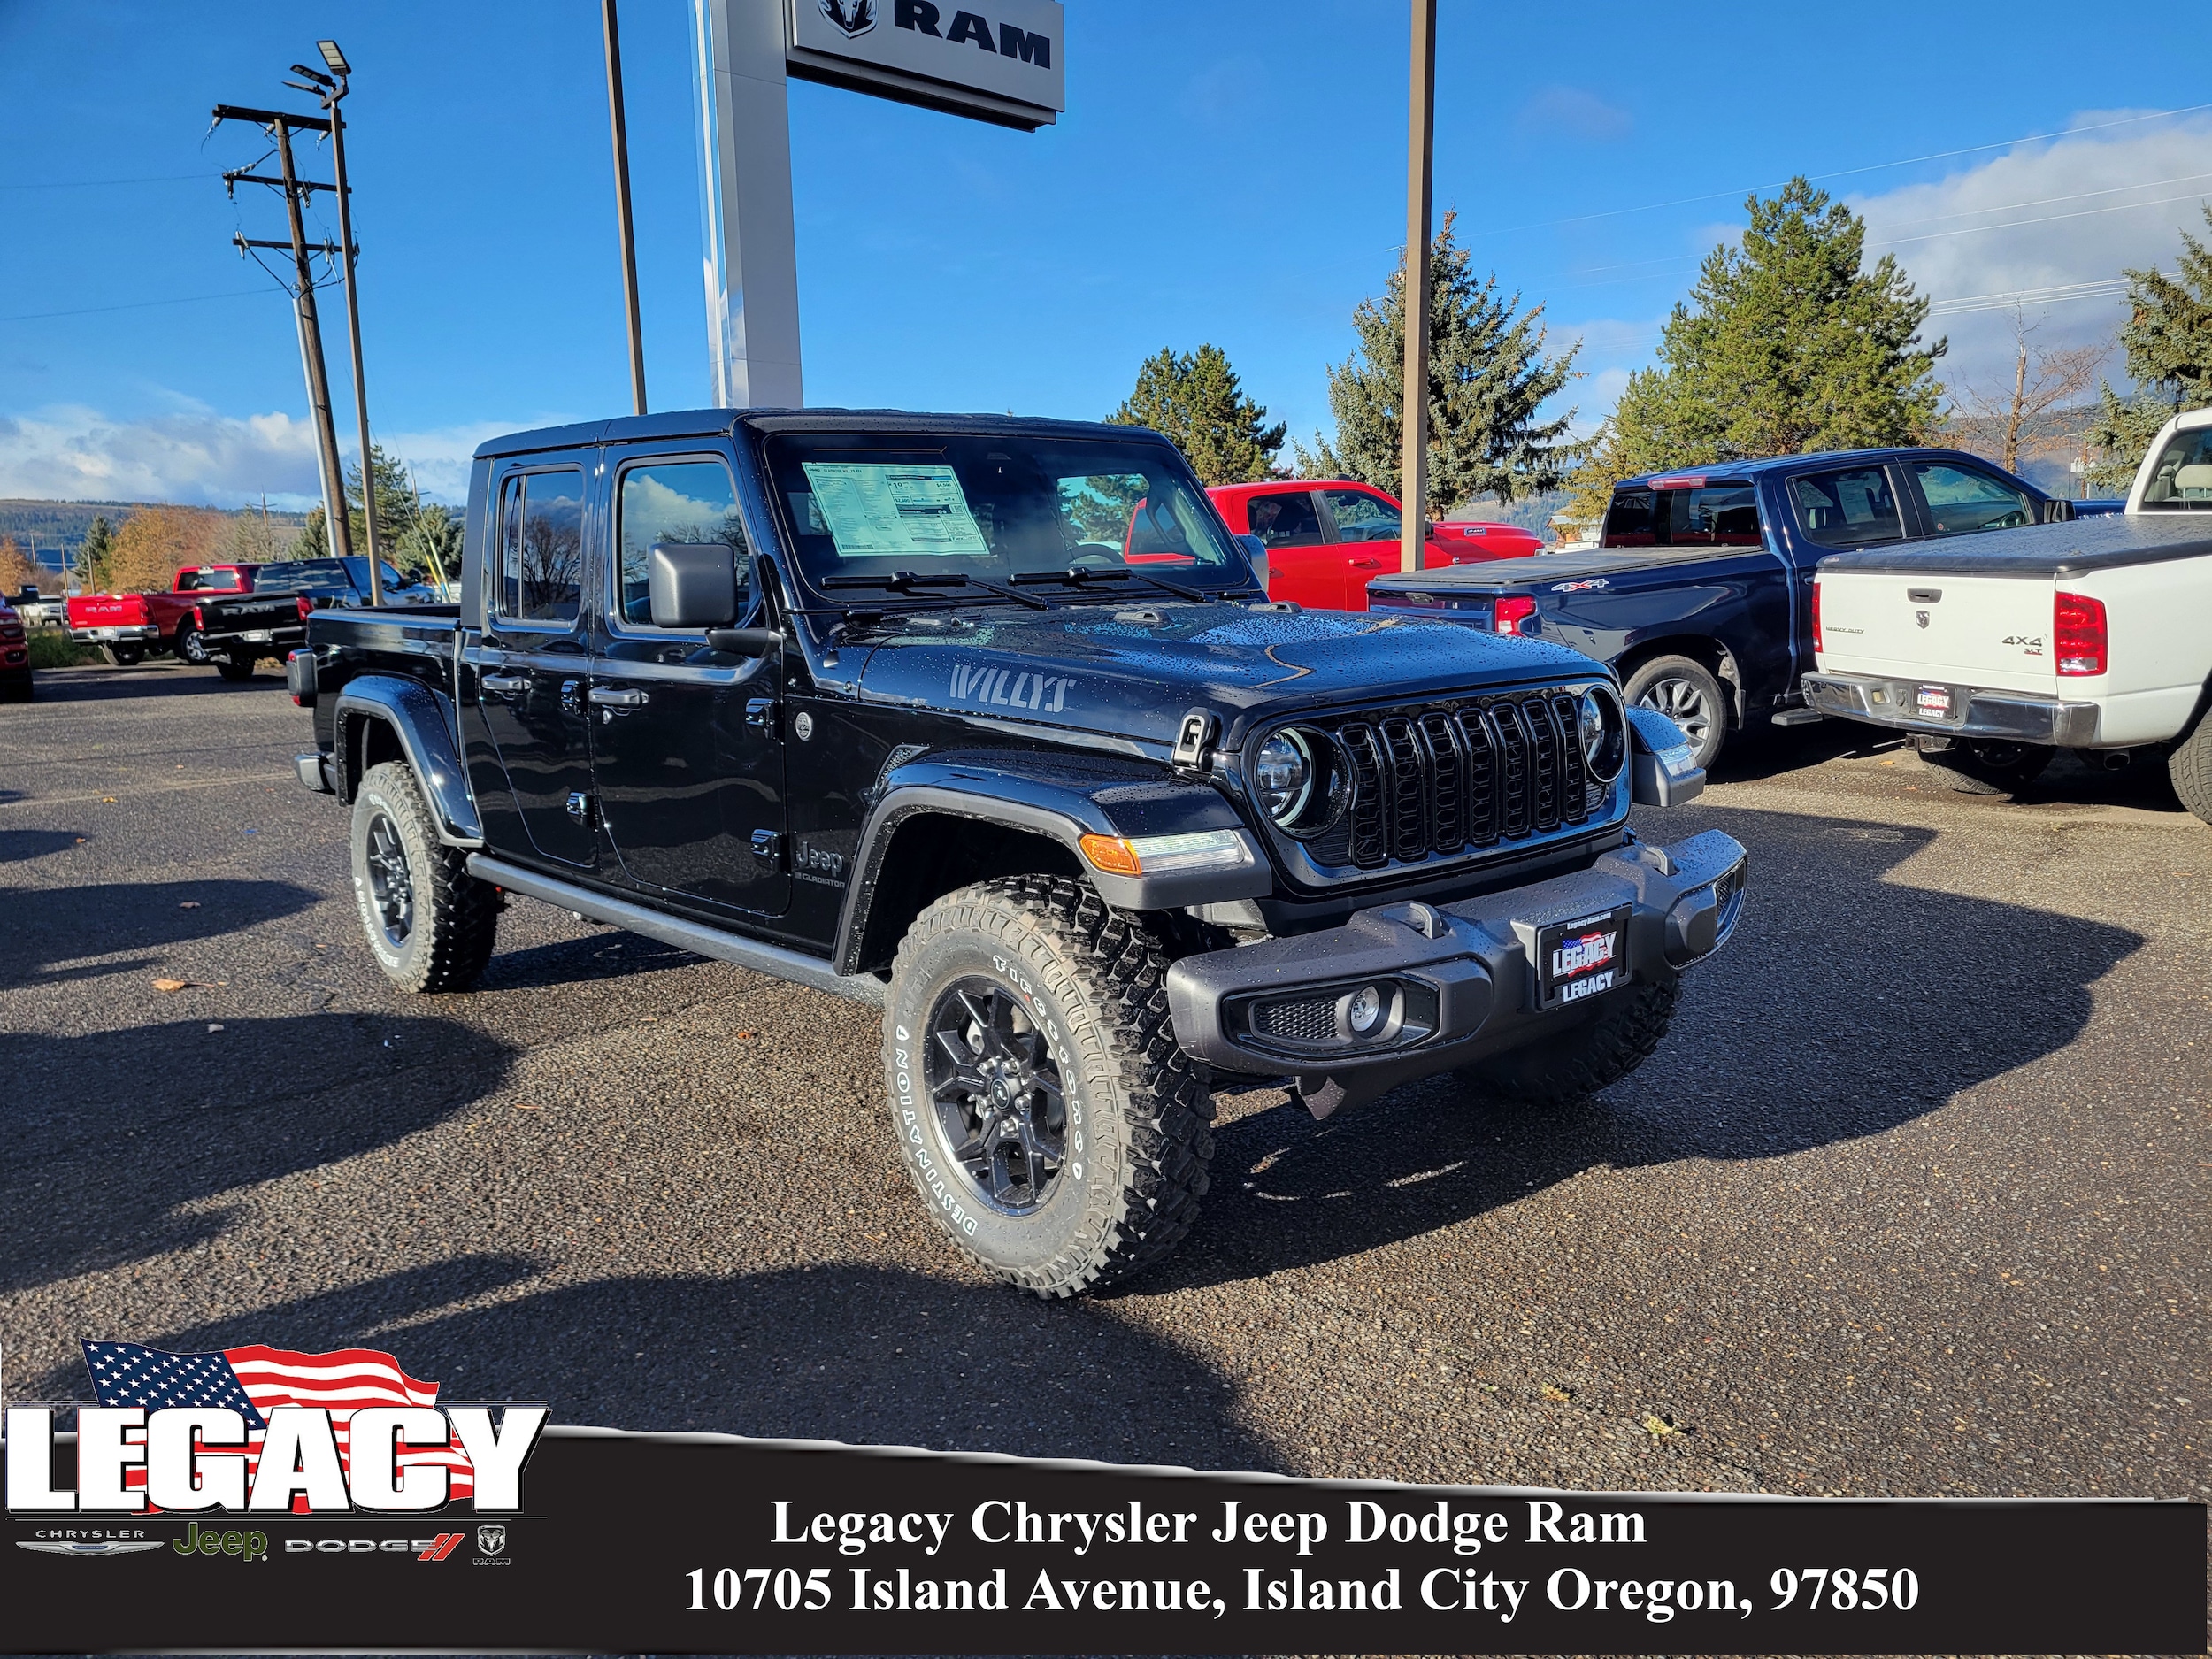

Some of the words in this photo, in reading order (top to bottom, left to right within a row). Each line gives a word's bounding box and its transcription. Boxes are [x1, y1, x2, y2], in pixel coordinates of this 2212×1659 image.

[895, 0, 1050, 69] RAM
[85, 605, 122, 614] RAM
[222, 605, 275, 616] RAM
[949, 664, 1077, 713] WILLYS
[1917, 693, 1949, 708] LEGACY
[1919, 708, 1944, 718] LEGACY
[796, 841, 843, 877] Jeep
[802, 873, 846, 889] GLADIATOR
[1553, 932, 1617, 976] LEGACY
[1563, 971, 1614, 1002] LEGACY
[895, 1048, 979, 1237] DESTINATION
